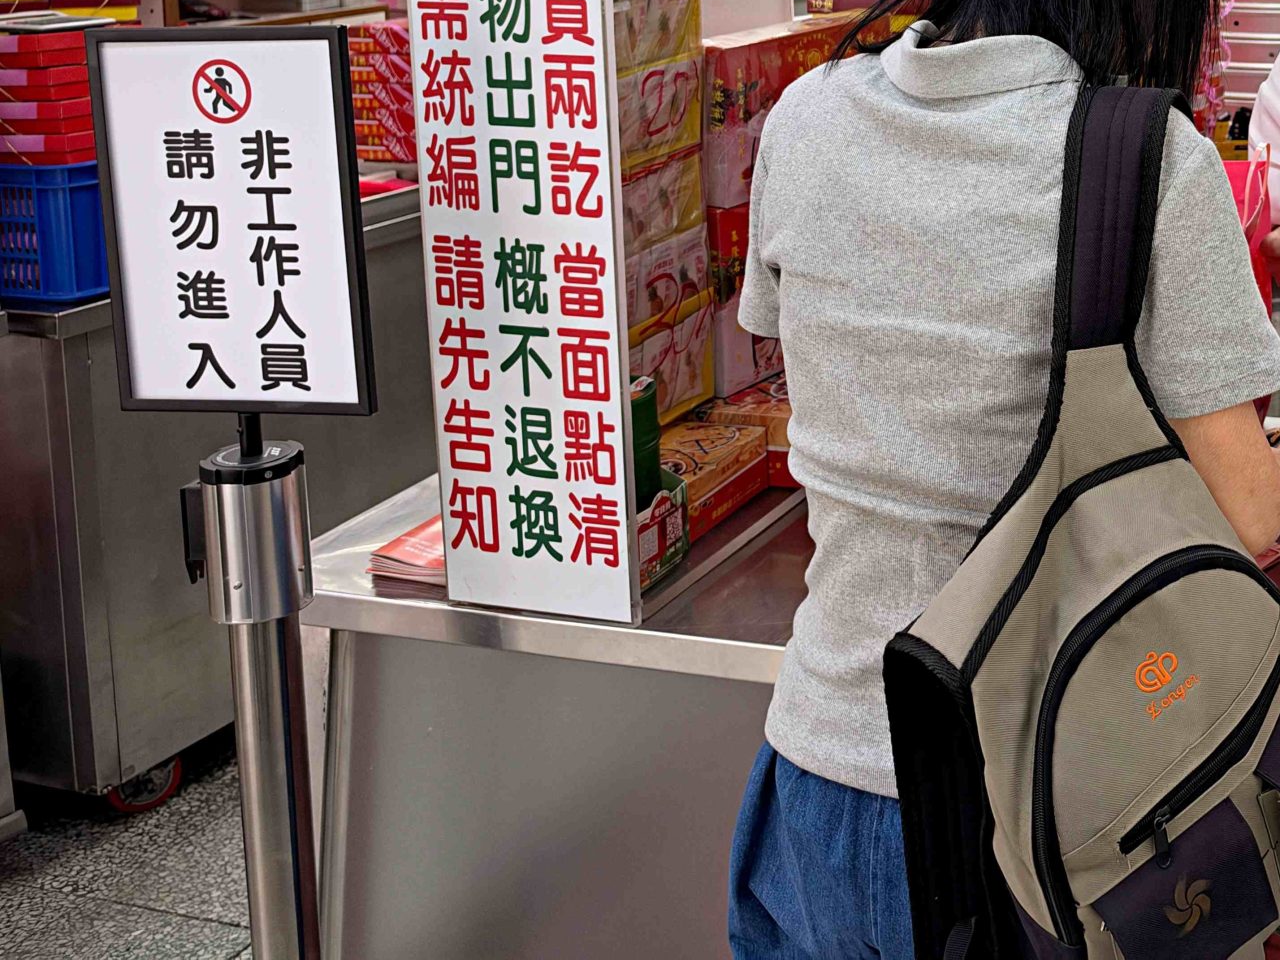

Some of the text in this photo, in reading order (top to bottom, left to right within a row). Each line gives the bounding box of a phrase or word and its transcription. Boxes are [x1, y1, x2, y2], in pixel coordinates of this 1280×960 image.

[163, 129, 236, 390] 請勿進入
[241, 130, 311, 392] 非工作人員
